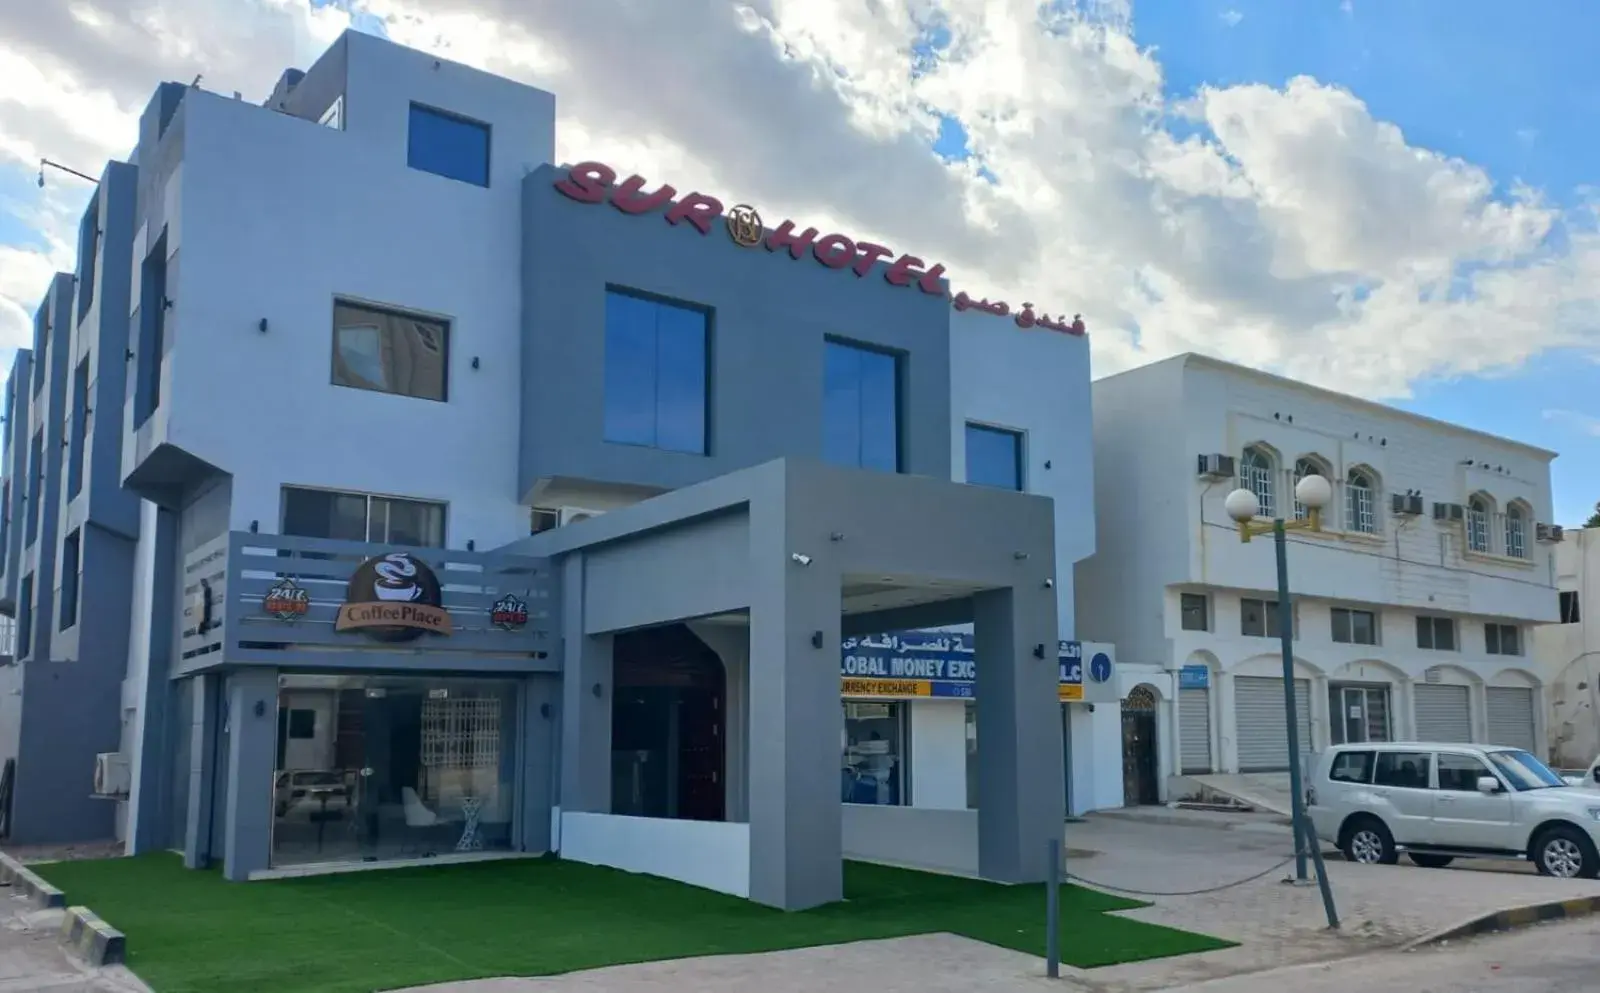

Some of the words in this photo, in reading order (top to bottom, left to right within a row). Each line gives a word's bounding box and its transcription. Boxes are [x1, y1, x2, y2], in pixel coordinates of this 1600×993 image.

[553, 161, 724, 236] SUR
[765, 219, 946, 295] HOTEL
[950, 291, 1010, 316] صو
[841, 656, 887, 675] OBAL
[891, 657, 945, 677] MONEY
[947, 660, 976, 679] EXC
[1059, 664, 1081, 681] LC
